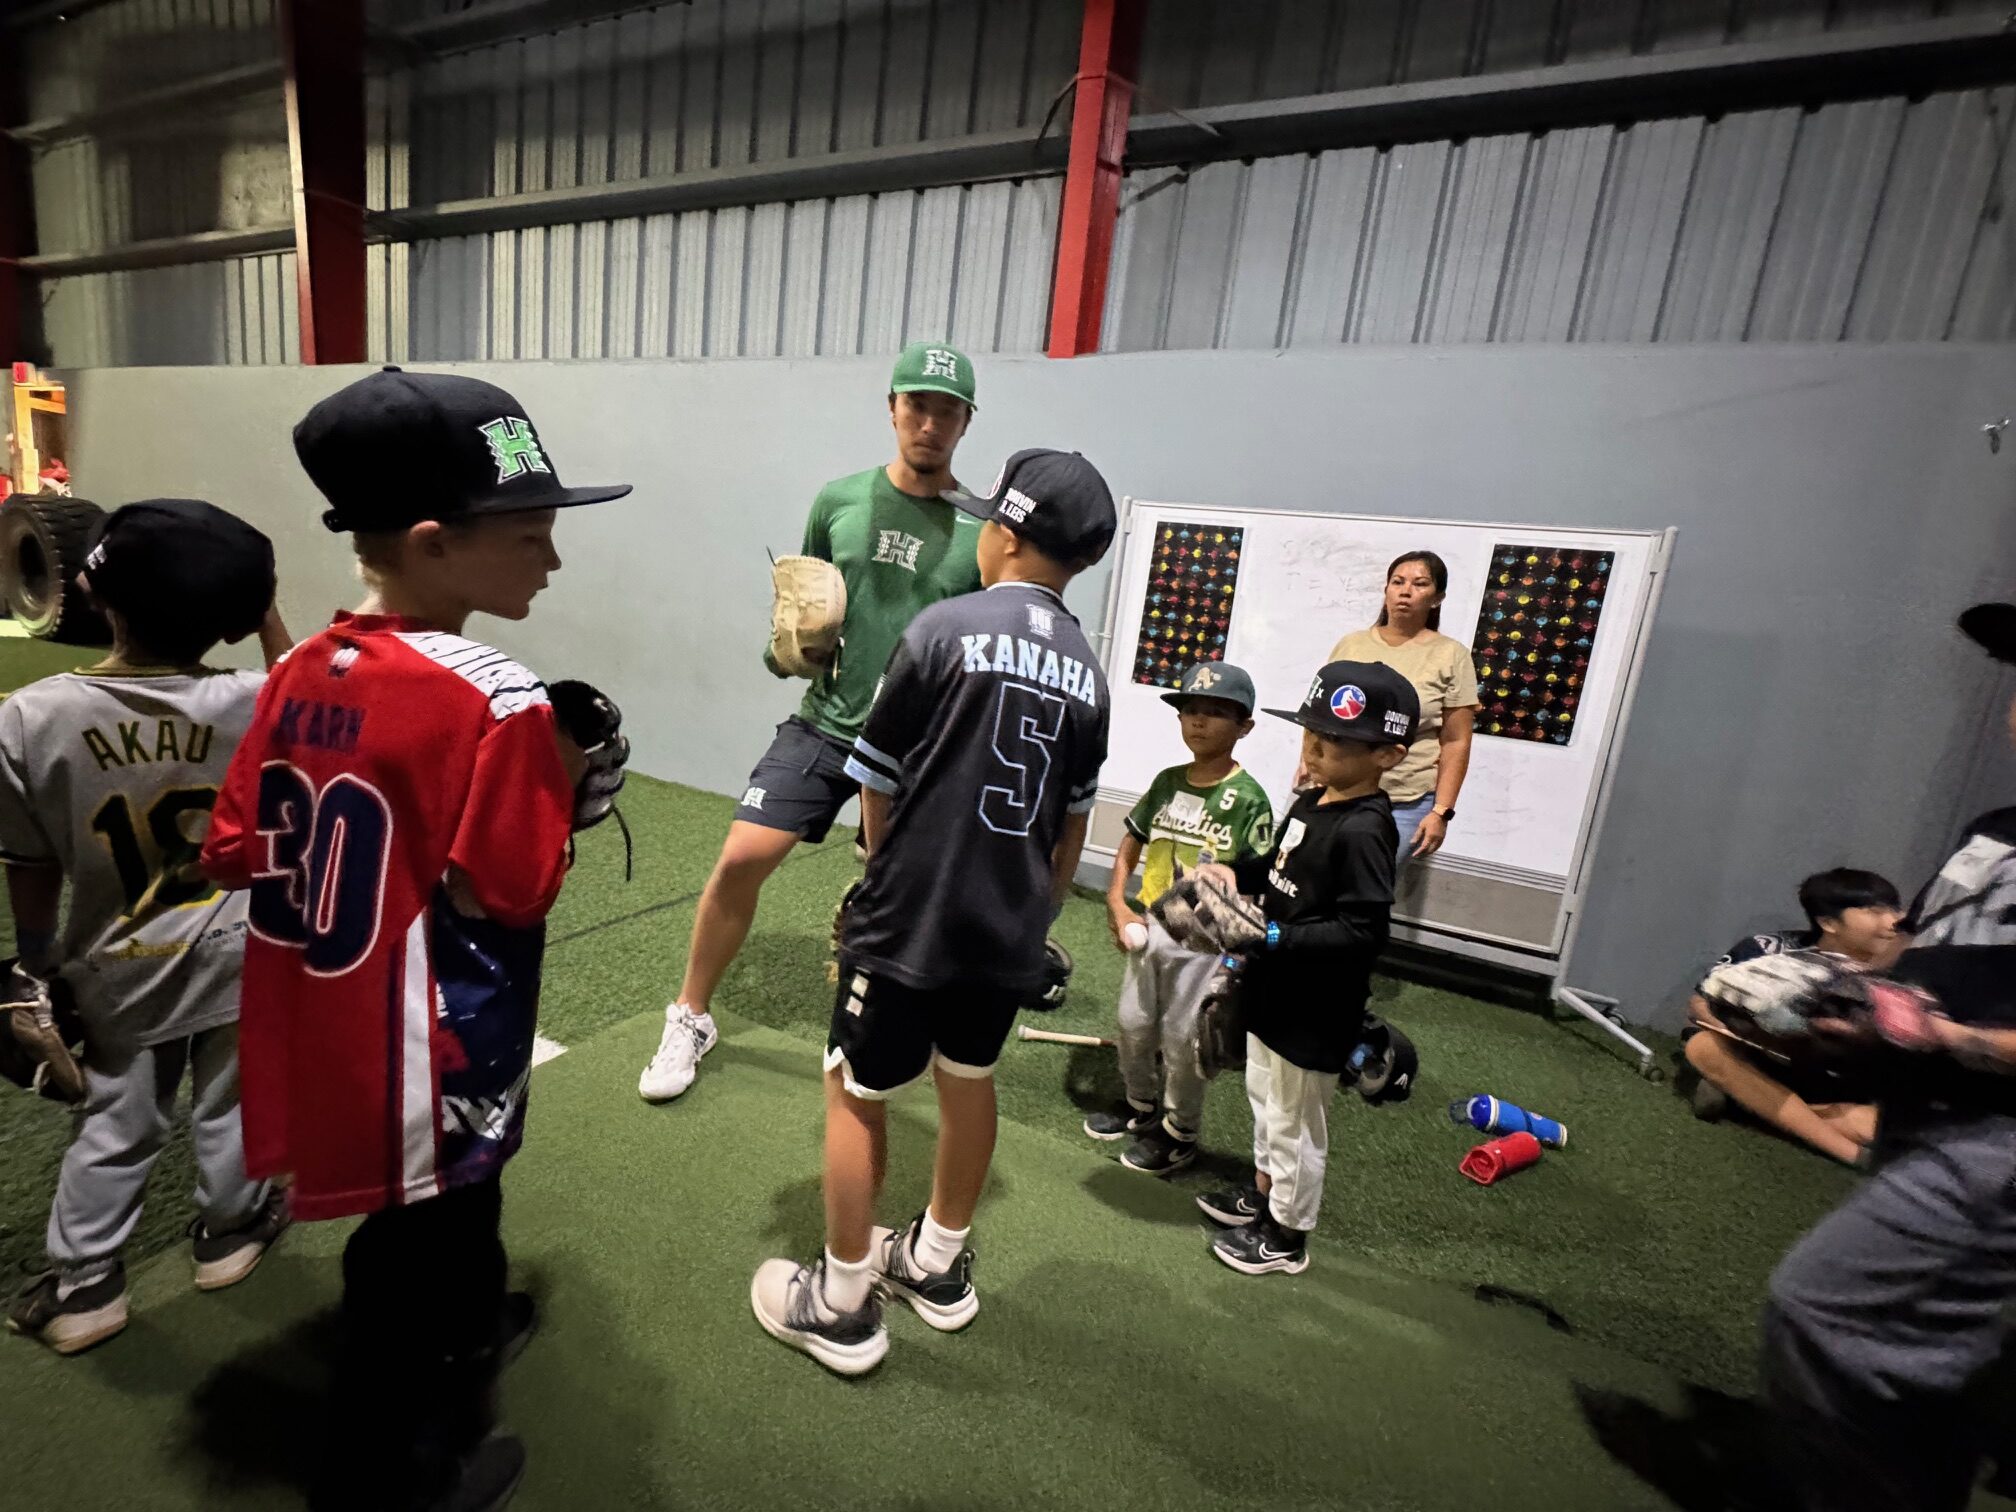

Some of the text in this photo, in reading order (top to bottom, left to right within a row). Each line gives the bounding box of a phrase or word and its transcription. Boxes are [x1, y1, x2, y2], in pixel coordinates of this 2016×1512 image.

[478, 416, 552, 485] H
[961, 633, 1096, 707] KANAHA
[81, 720, 214, 772] AKAU
[979, 681, 1066, 837] 5
[1219, 788, 1239, 811] 5
[248, 759, 394, 979] 30
